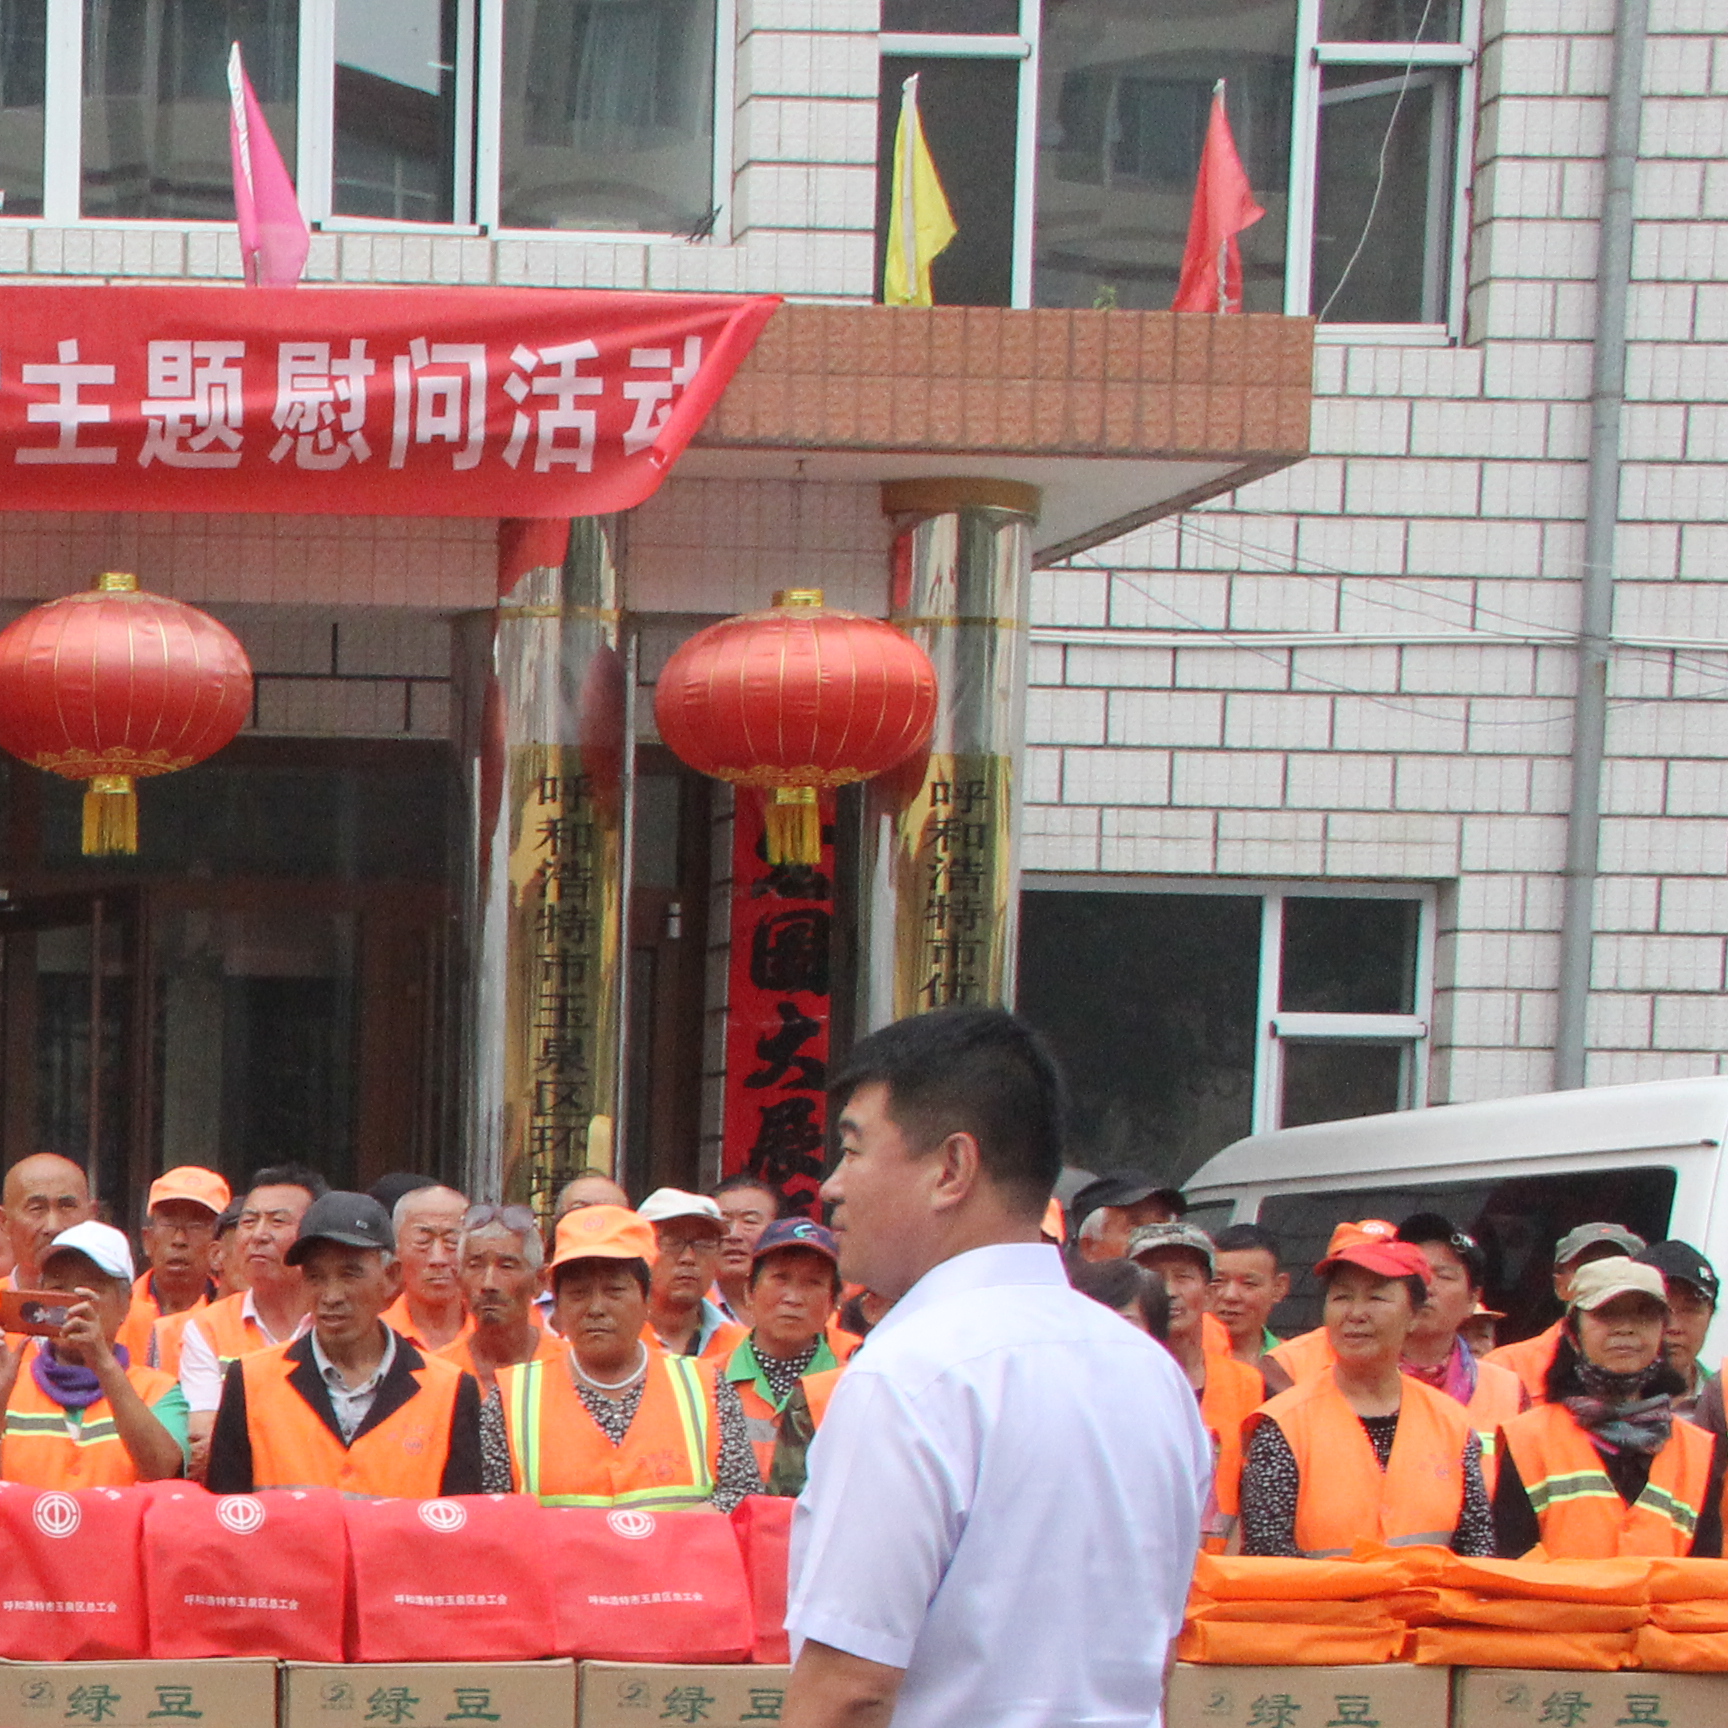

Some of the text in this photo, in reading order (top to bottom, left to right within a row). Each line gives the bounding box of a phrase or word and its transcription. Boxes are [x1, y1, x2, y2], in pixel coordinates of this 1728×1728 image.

[64, 1684, 202, 1723] 绿豆
[363, 1685, 501, 1724] 绿豆
[659, 1686, 783, 1724] 绿豆
[1538, 1689, 1671, 1728] 绿豆
